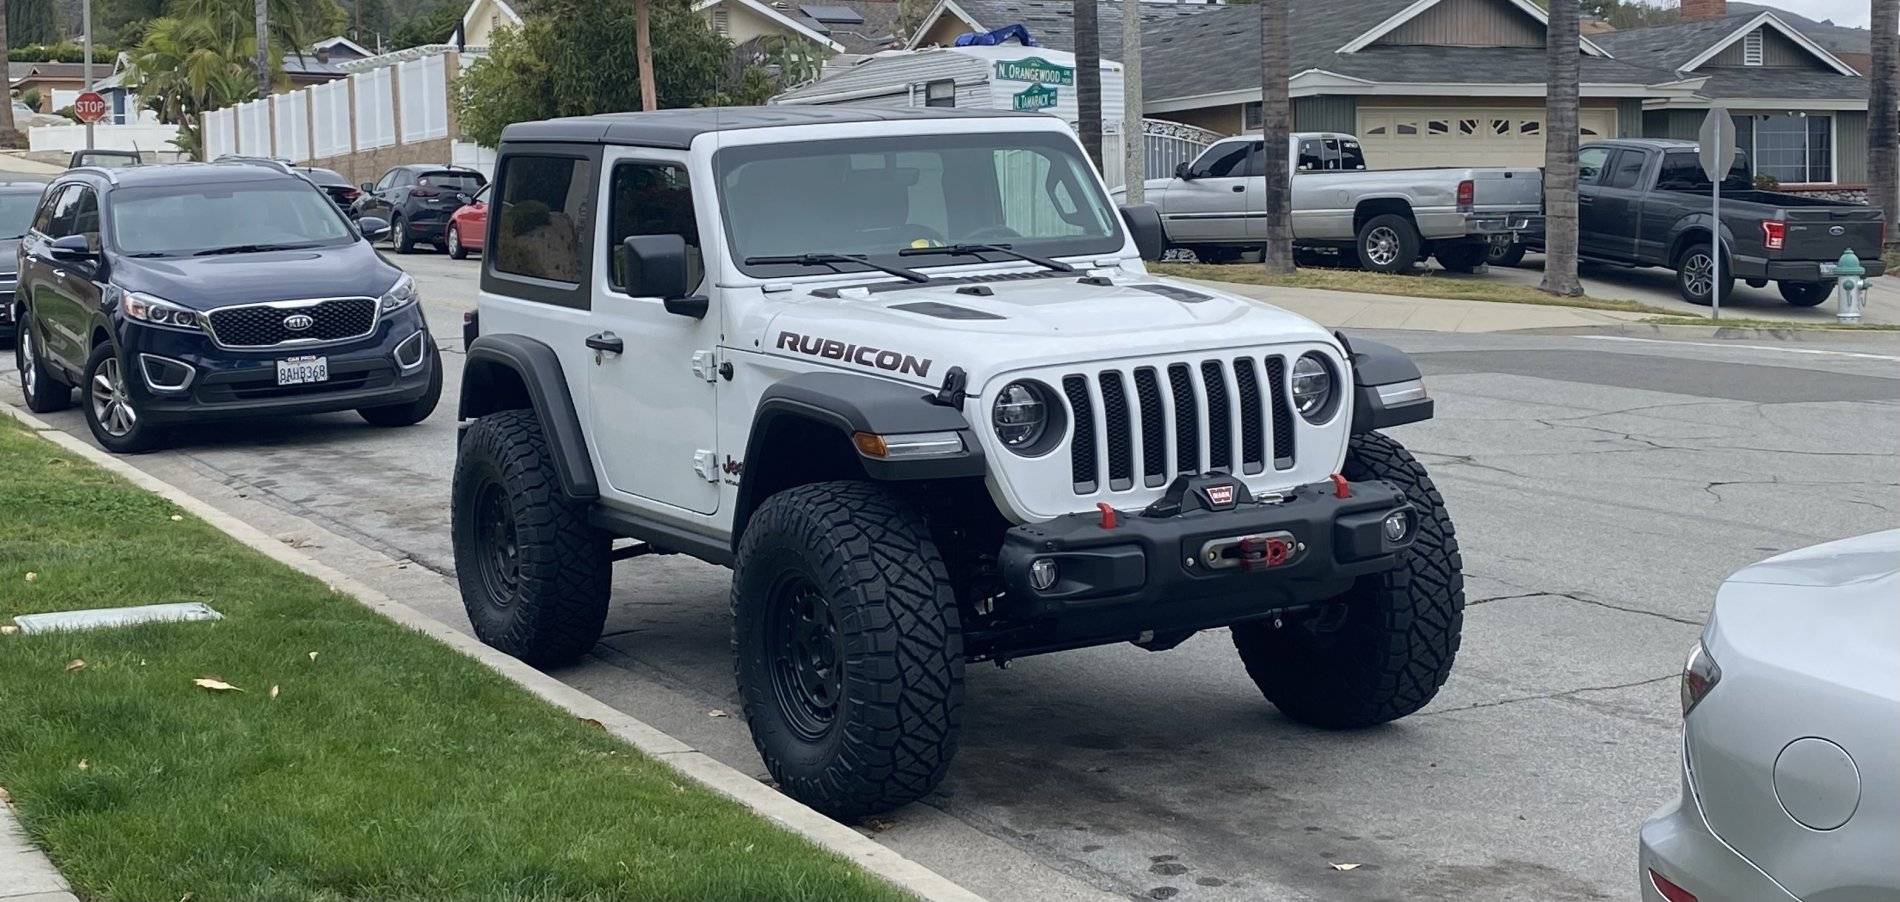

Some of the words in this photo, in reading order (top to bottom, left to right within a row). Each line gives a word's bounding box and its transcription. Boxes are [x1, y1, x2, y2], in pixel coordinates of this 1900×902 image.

[1009, 64, 1060, 83] ORANGEWOOD
[76, 101, 104, 113] STOP
[1021, 94, 1049, 108] TAMARACK
[288, 318, 308, 328] KIA
[776, 331, 932, 378] RUBICON
